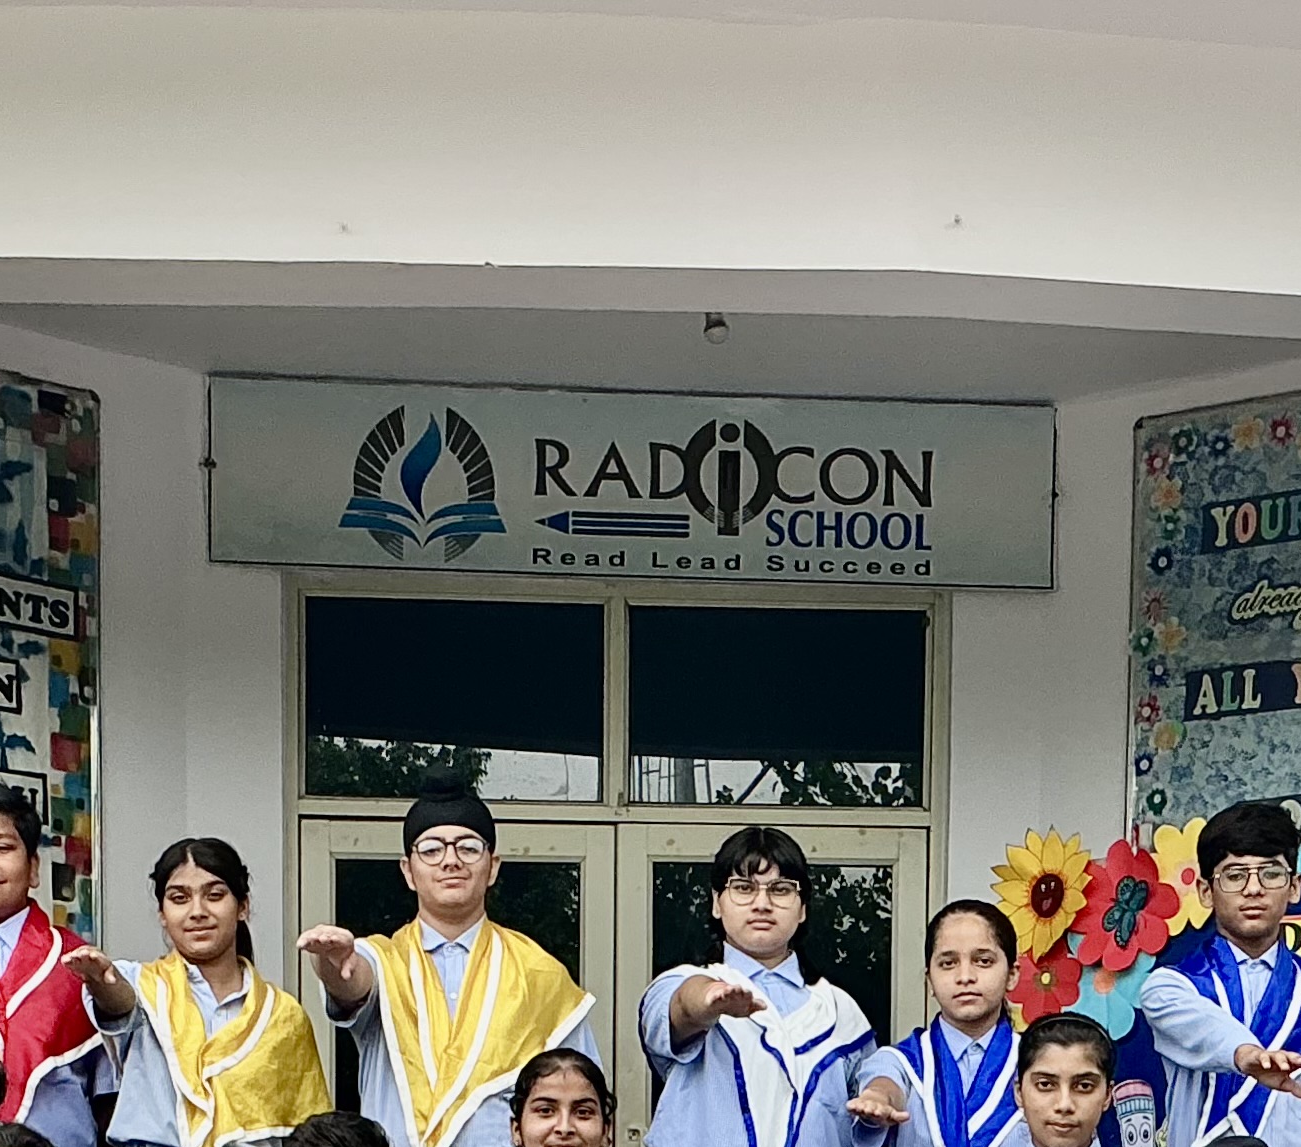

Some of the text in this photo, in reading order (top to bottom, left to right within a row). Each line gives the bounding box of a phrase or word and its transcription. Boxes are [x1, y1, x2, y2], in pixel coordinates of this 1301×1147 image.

[765, 508, 933, 551] SCHOOL
[531, 547, 933, 577] Read Lead Succeed
[1192, 667, 1262, 716] ALL
